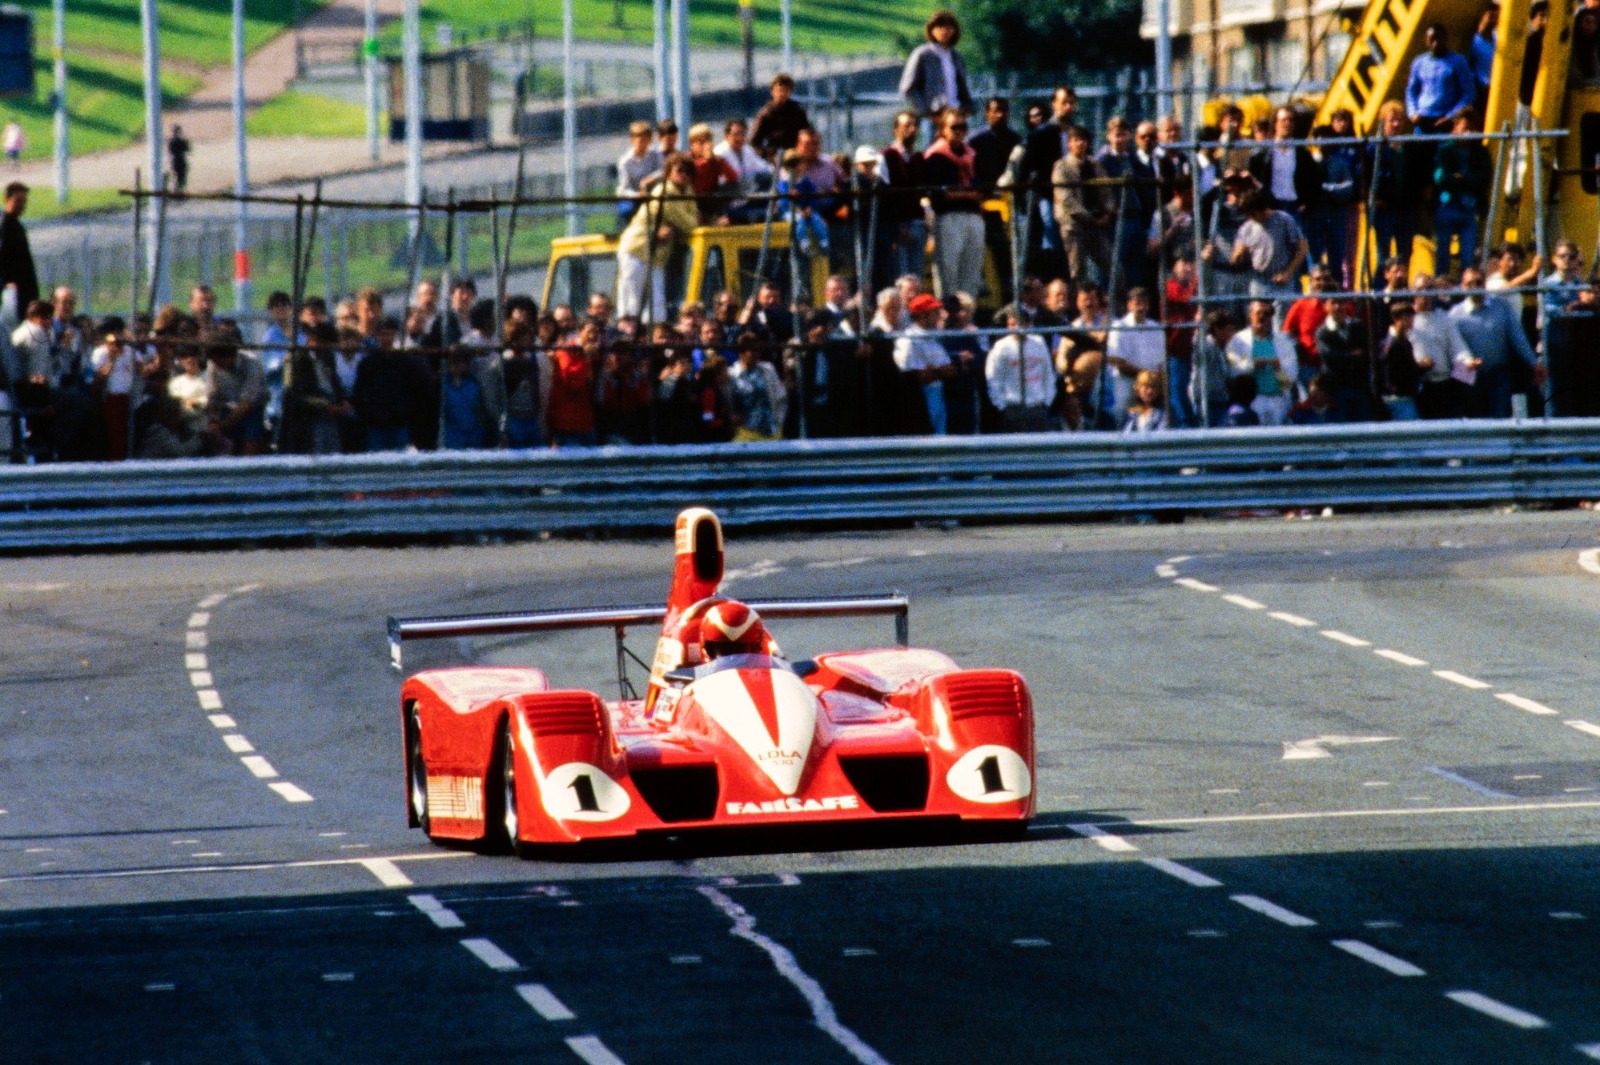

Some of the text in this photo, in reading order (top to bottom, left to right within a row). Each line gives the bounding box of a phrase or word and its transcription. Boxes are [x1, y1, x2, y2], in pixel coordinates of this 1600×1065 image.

[1348, 0, 1412, 110] INT
[758, 749, 803, 761] LOLA
[567, 774, 608, 813] 1
[974, 755, 1014, 795] 1
[725, 795, 859, 815] FAILSAFE
